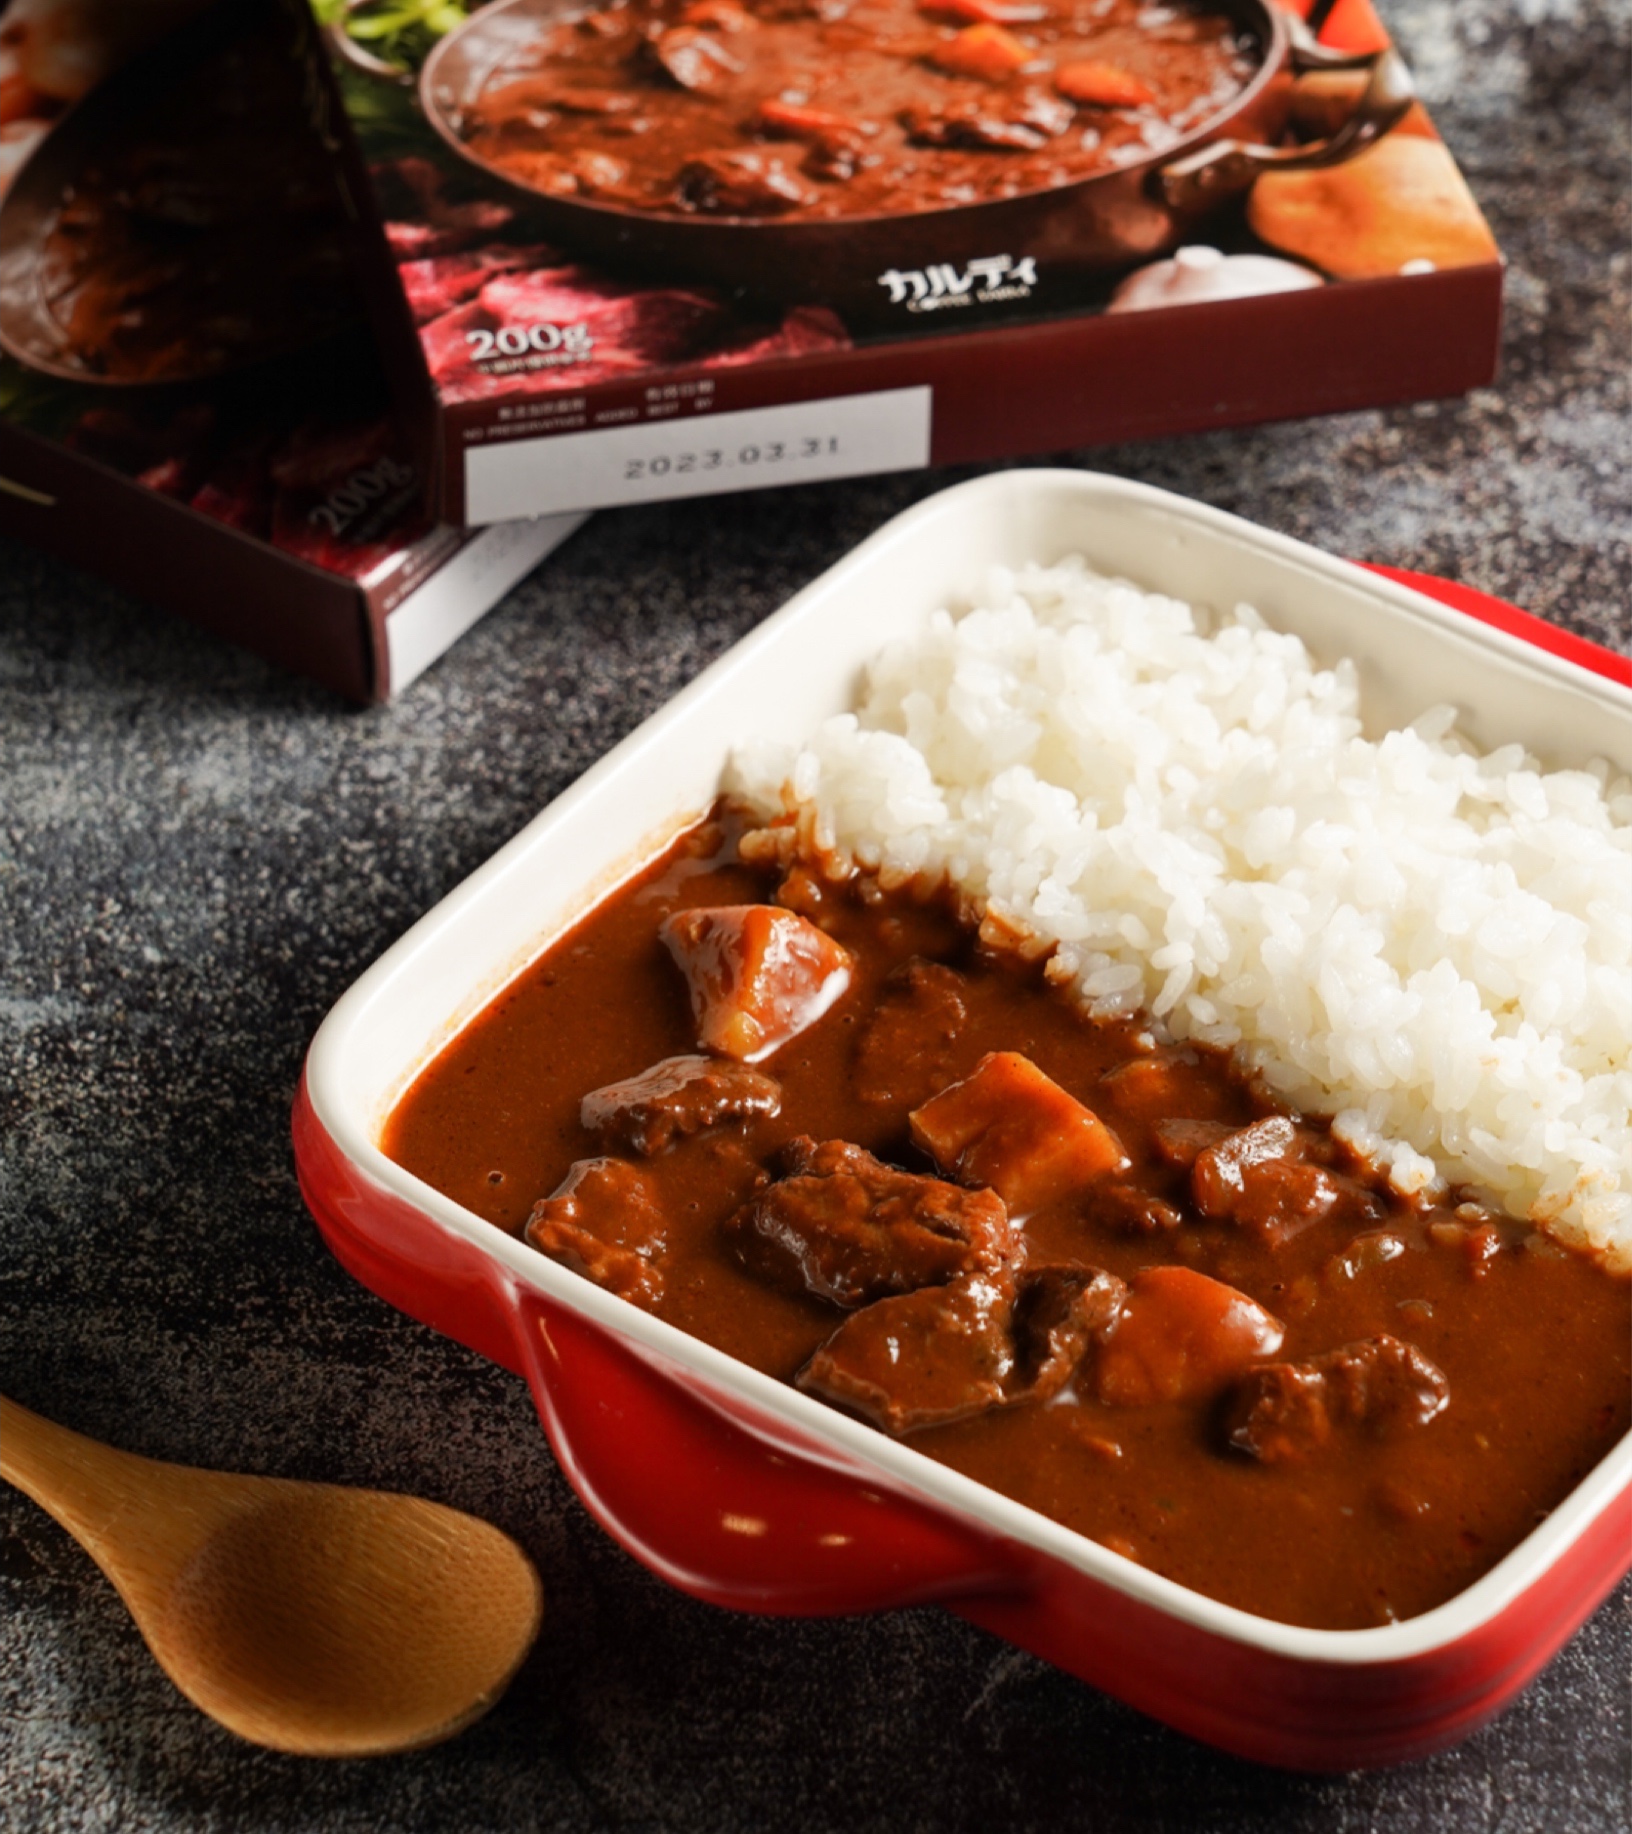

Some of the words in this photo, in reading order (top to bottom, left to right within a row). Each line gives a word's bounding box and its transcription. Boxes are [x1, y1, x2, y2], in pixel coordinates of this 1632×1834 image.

[877, 253, 1037, 303] カルディ
[466, 322, 594, 361] 200g
[624, 436, 840, 480] 2023.03.31
